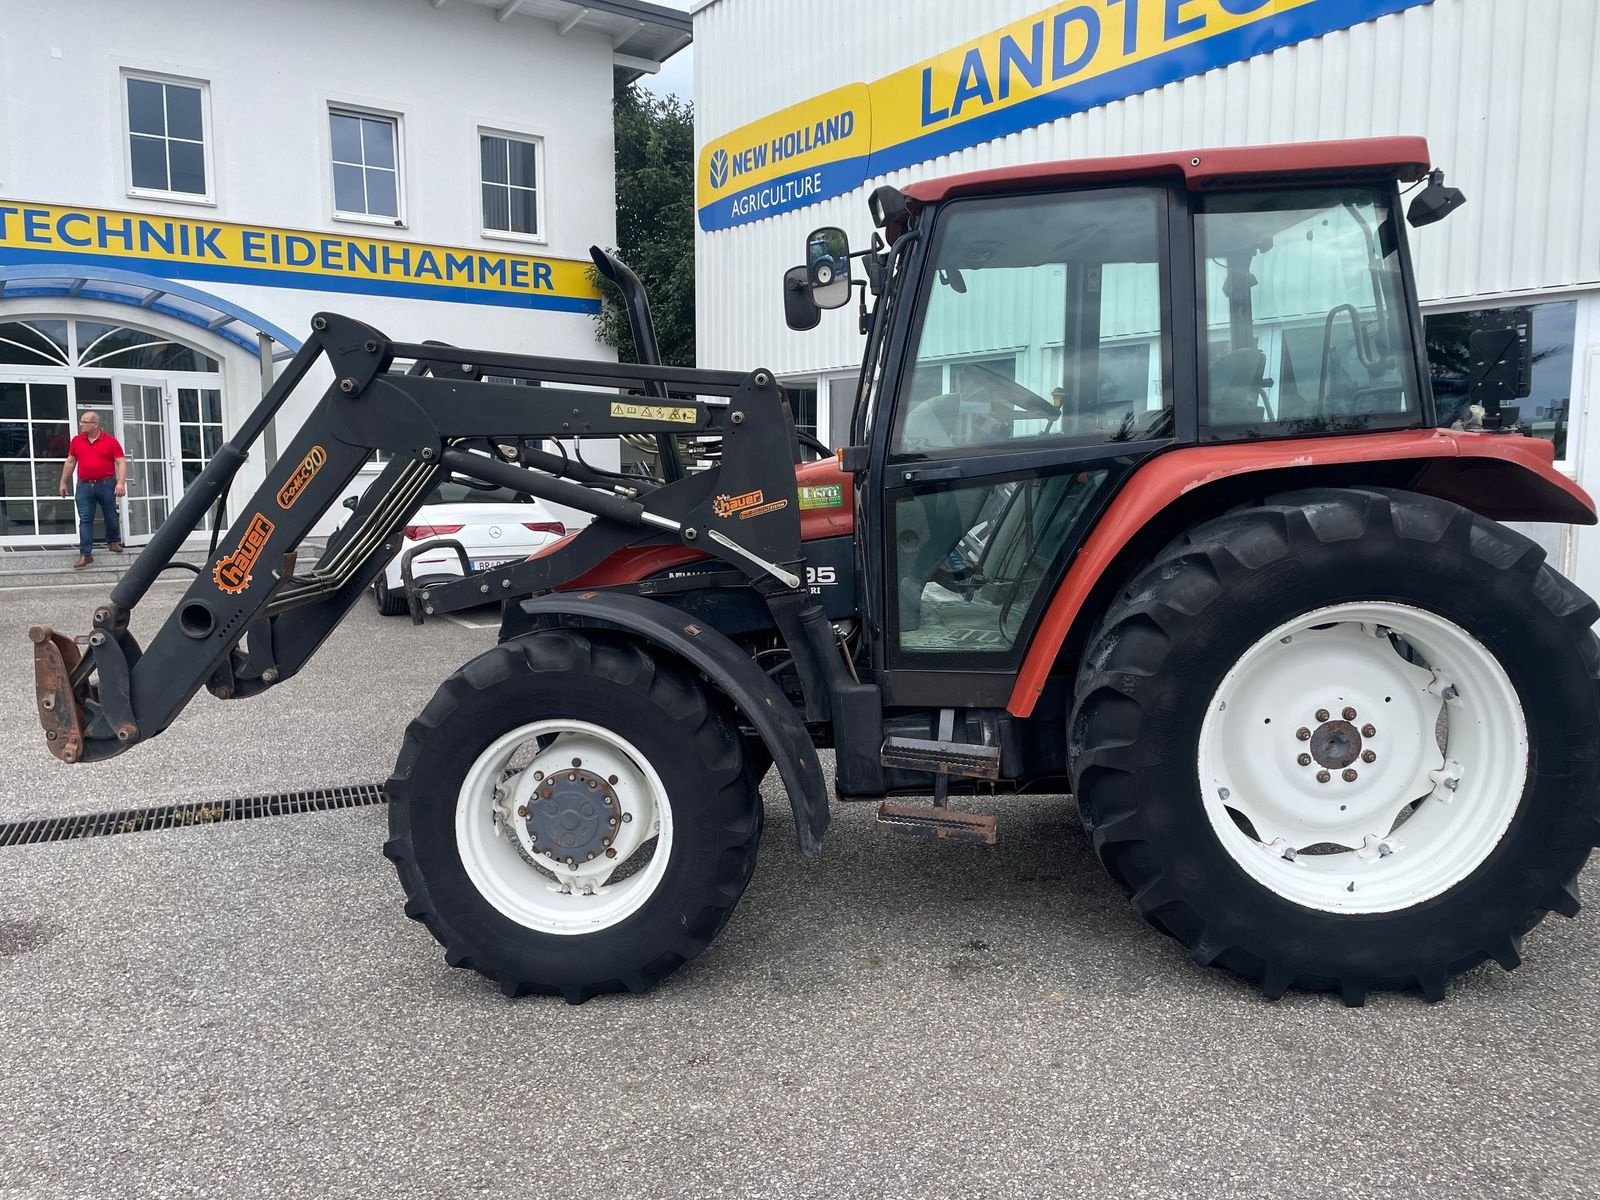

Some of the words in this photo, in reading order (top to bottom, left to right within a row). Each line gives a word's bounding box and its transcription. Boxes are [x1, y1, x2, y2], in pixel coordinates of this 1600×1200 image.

[921, 0, 1270, 127] LANDTE
[732, 143, 768, 178] NEW
[771, 110, 854, 164] HOLLAND
[731, 172, 822, 218] AGRICULTURE
[242, 230, 555, 290] EIDENHAMMER
[721, 493, 761, 513] hauer
[221, 519, 266, 585] hauer
